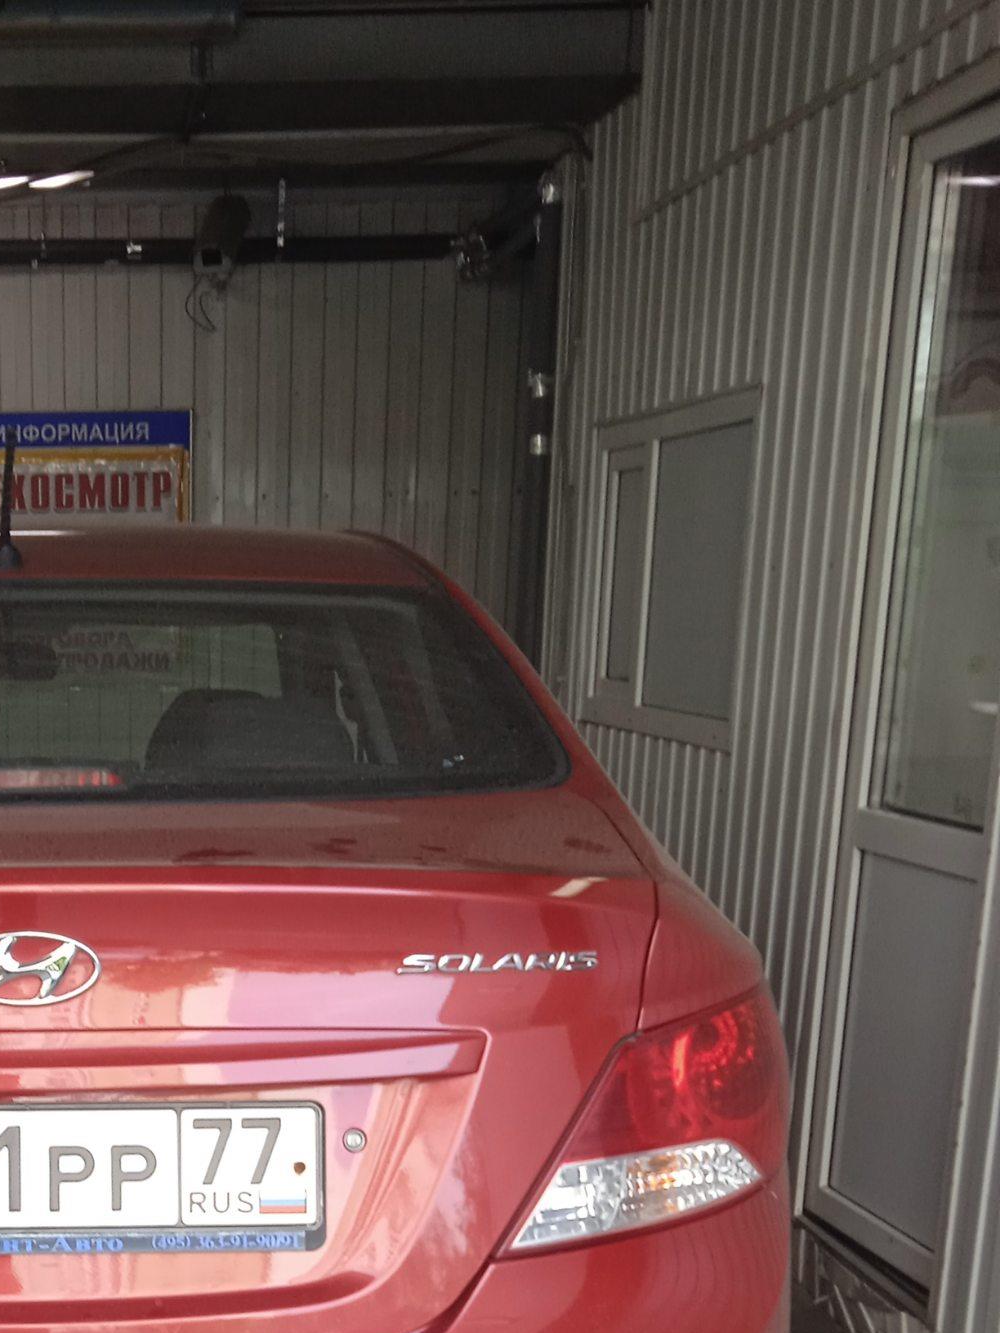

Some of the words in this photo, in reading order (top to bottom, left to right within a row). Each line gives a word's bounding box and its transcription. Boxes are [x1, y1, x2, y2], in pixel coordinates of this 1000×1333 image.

[396, 951, 599, 975] SOLARIS
[192, 1117, 282, 1185] 77
[189, 1191, 254, 1214] RUS
